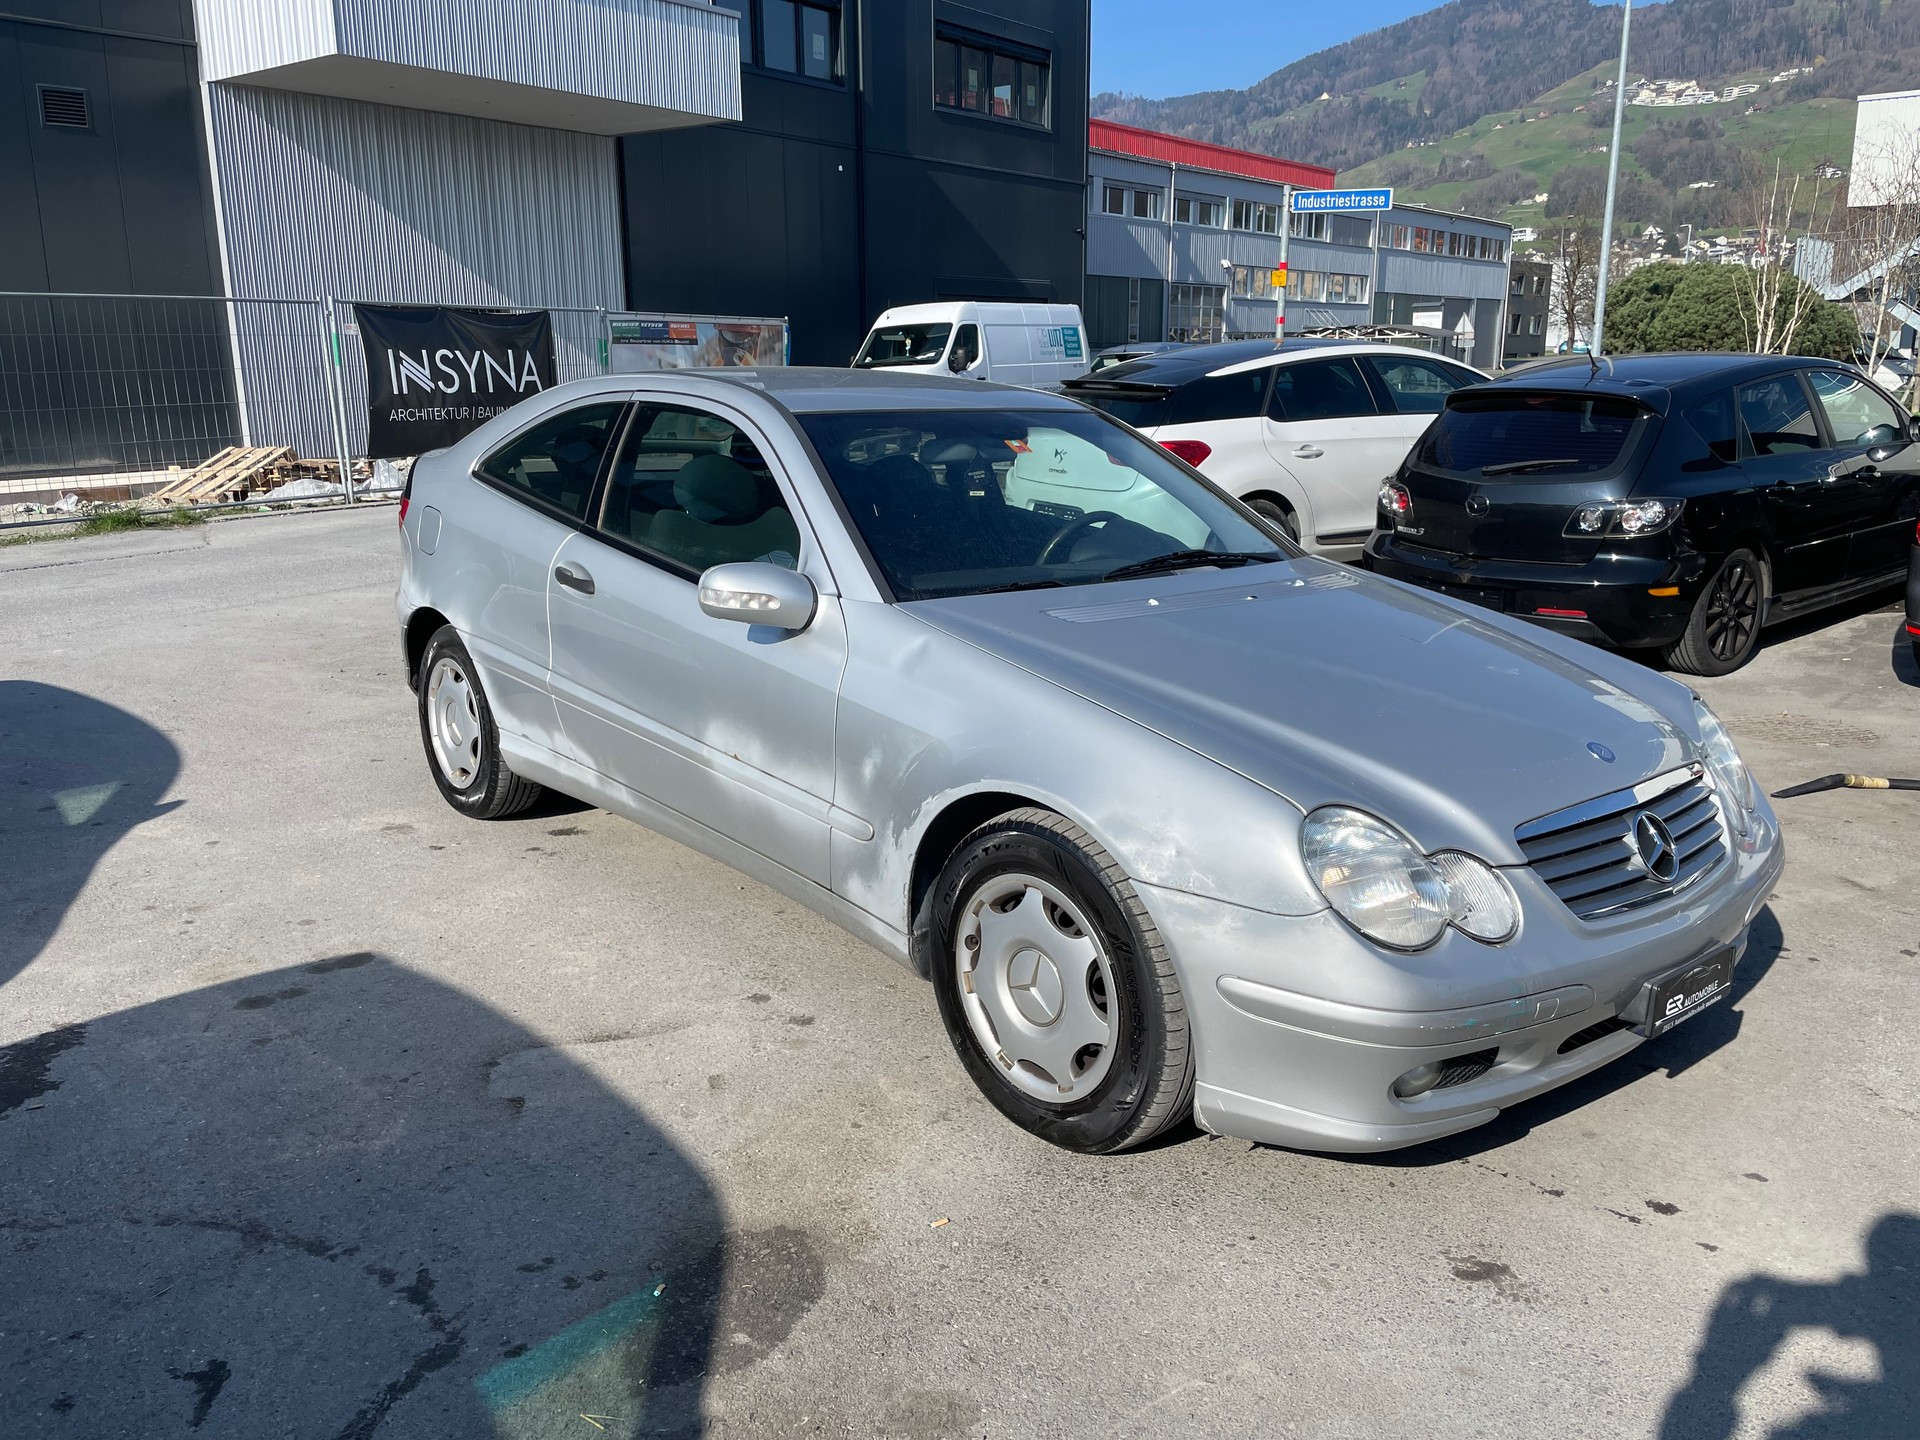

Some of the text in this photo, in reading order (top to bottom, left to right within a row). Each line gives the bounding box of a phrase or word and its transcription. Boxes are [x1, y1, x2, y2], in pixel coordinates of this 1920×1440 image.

[1297, 193, 1386, 209] Industriestrasse
[387, 348, 543, 395] INSYNA
[389, 406, 470, 422] ARCHITEKTUR
[477, 405, 513, 419] BAUI
[1684, 980, 1719, 1008] AUTOMOBILE
